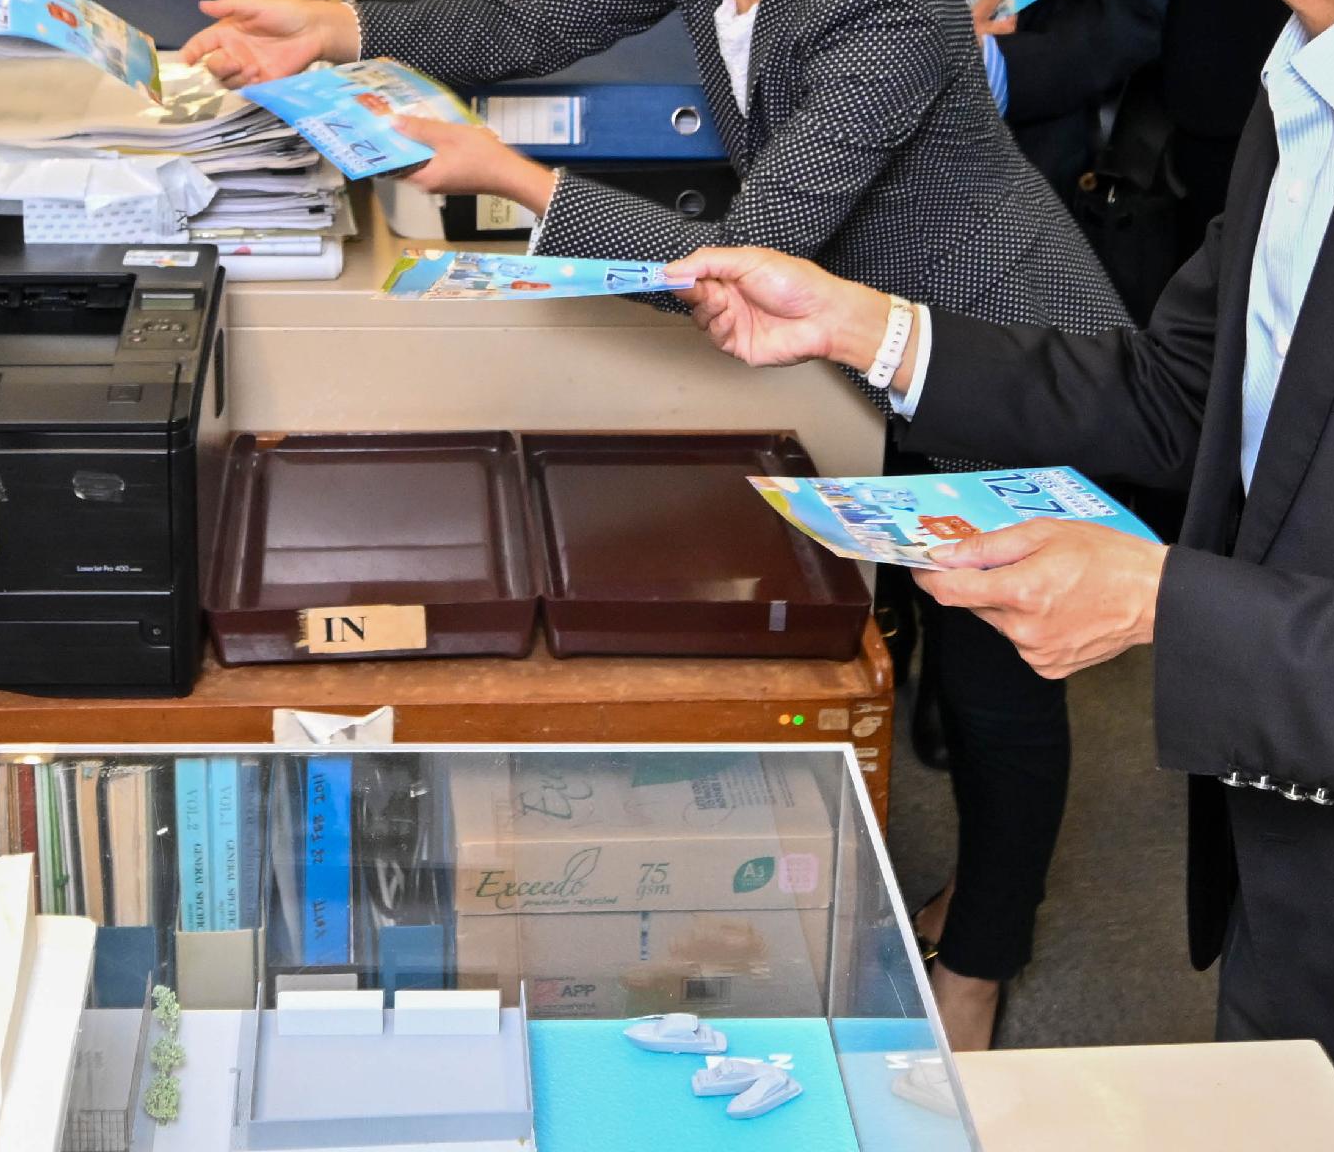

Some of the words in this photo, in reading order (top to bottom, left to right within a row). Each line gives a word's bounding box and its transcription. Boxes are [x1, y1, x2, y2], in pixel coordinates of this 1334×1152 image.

[982, 473, 1041, 497] 12
[1011, 500, 1067, 513] 7
[323, 616, 366, 643] IN
[194, 843, 205, 886] GENERAL
[227, 839, 237, 881] GENERAL
[744, 863, 765, 878] A3
[638, 862, 670, 884] 75
[636, 884, 671, 900] gsm
[561, 984, 596, 998] APP
